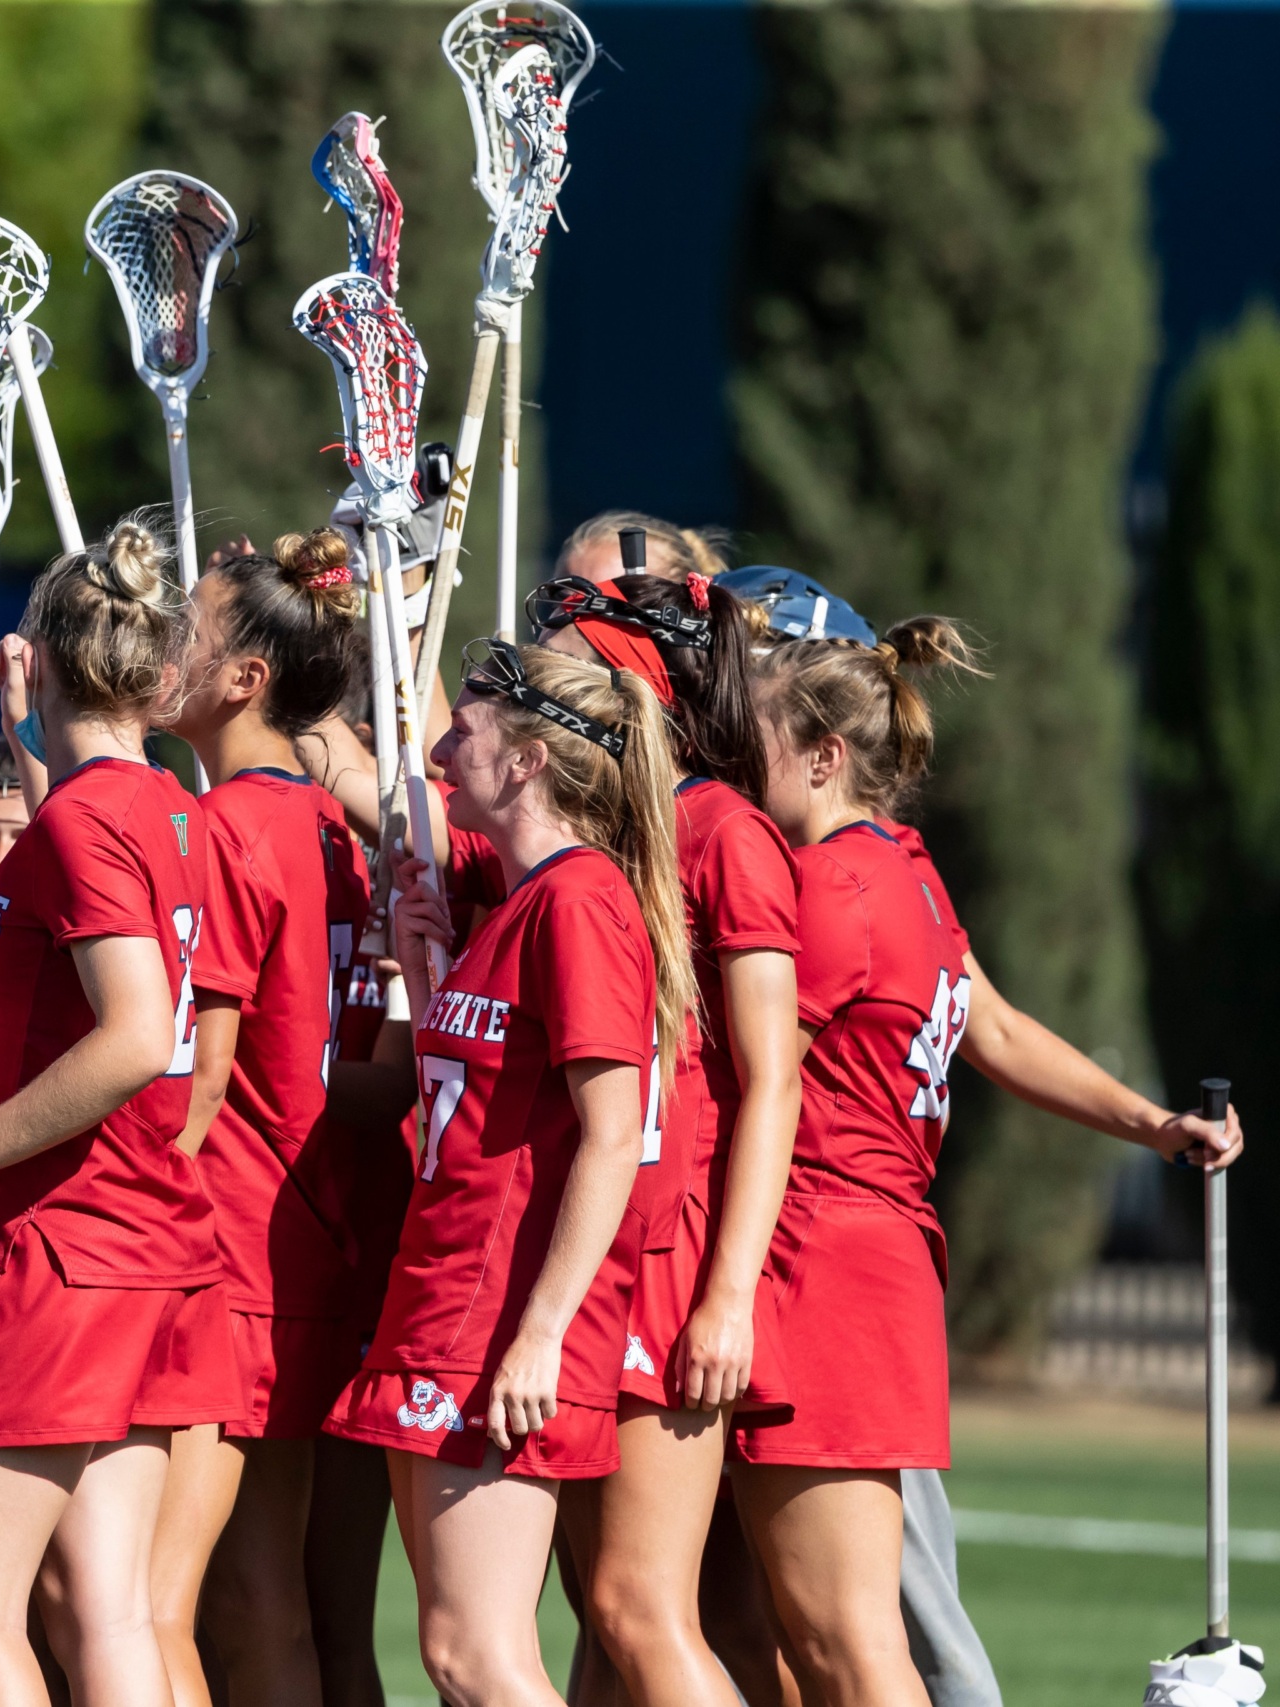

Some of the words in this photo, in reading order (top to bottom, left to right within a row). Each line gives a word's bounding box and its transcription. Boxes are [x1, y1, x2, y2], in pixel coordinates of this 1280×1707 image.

[444, 463, 472, 533] STX
[536, 701, 592, 736] STX
[429, 990, 512, 1043] STATE
